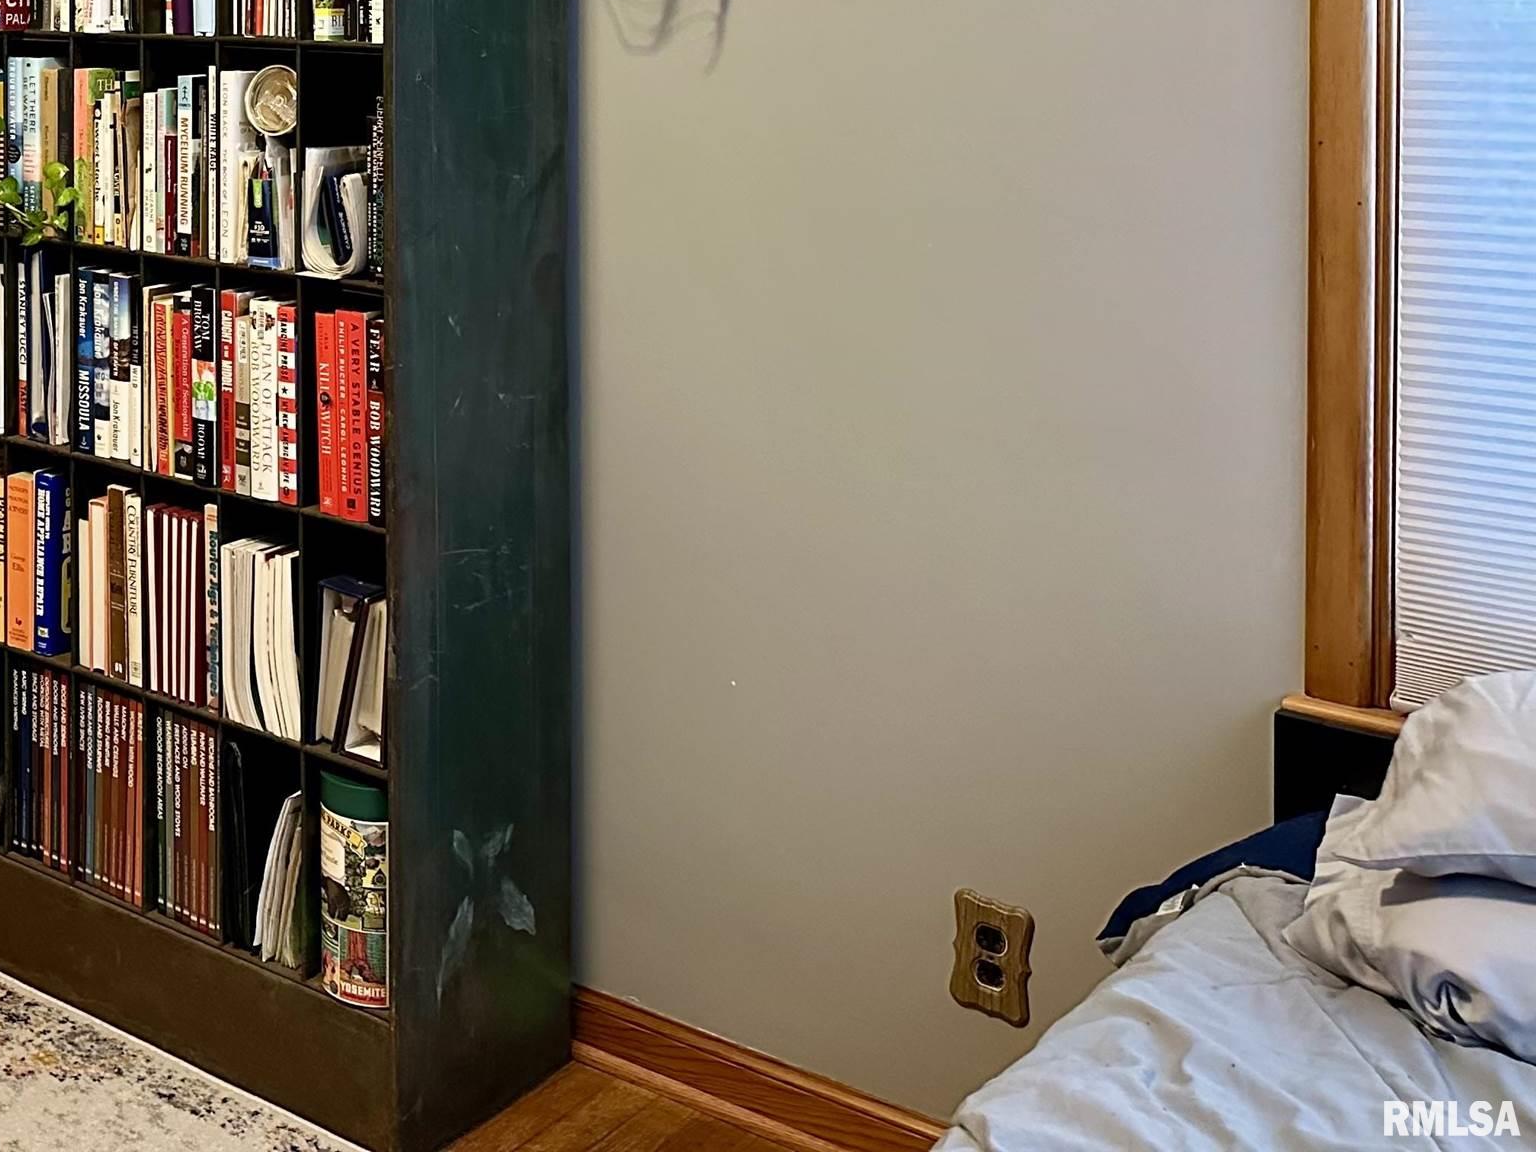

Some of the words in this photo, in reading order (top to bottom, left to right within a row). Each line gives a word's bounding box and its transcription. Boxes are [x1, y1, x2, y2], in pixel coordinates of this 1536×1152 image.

[180, 117, 188, 173] MYCELIUM
[180, 176, 188, 225] RUNNING
[78, 278, 87, 294] Jon
[94, 285, 103, 304] Jon
[79, 295, 87, 338] Krakauer
[95, 309, 104, 356] Krakauer
[193, 300, 202, 352] BROKAW
[201, 313, 210, 340] TOM
[221, 310, 232, 344] CAUGHT
[350, 323, 359, 331] A
[251, 341, 259, 370] BOB
[262, 343, 271, 381] PLAN
[351, 339, 360, 375] VERY
[369, 328, 380, 372] FEAR
[182, 379, 189, 387] of
[221, 360, 232, 392] MIDDLE
[319, 362, 329, 393] KILL
[78, 370, 89, 430] MISSOULA
[112, 400, 120, 414] Jon
[181, 390, 189, 437] Sociopaths
[262, 388, 271, 406] OF
[282, 400, 289, 411] MY
[352, 382, 361, 435] STABLE
[369, 400, 380, 430] BOB
[112, 415, 120, 452] Krakauer
[196, 423, 206, 459] BOOM!
[251, 375, 260, 472] WOODWARD
[320, 404, 331, 454] SWITCH
[263, 413, 272, 473] ATTACK
[353, 442, 362, 496] GENIUS
[369, 435, 381, 517] WOODWARD
[37, 488, 45, 516] HOME
[37, 521, 45, 576] APPLIANCE
[127, 505, 136, 555] COUNTRY
[209, 530, 218, 577] Router
[36, 577, 44, 616] REPAIR
[128, 558, 138, 616] FURNITURE
[208, 578, 218, 605] Jigs
[210, 608, 218, 617] &
[209, 622, 218, 696] Techniques
[182, 756, 188, 769] ON
[326, 816, 352, 839] PARKS
[340, 980, 387, 998] YOSEMITE
